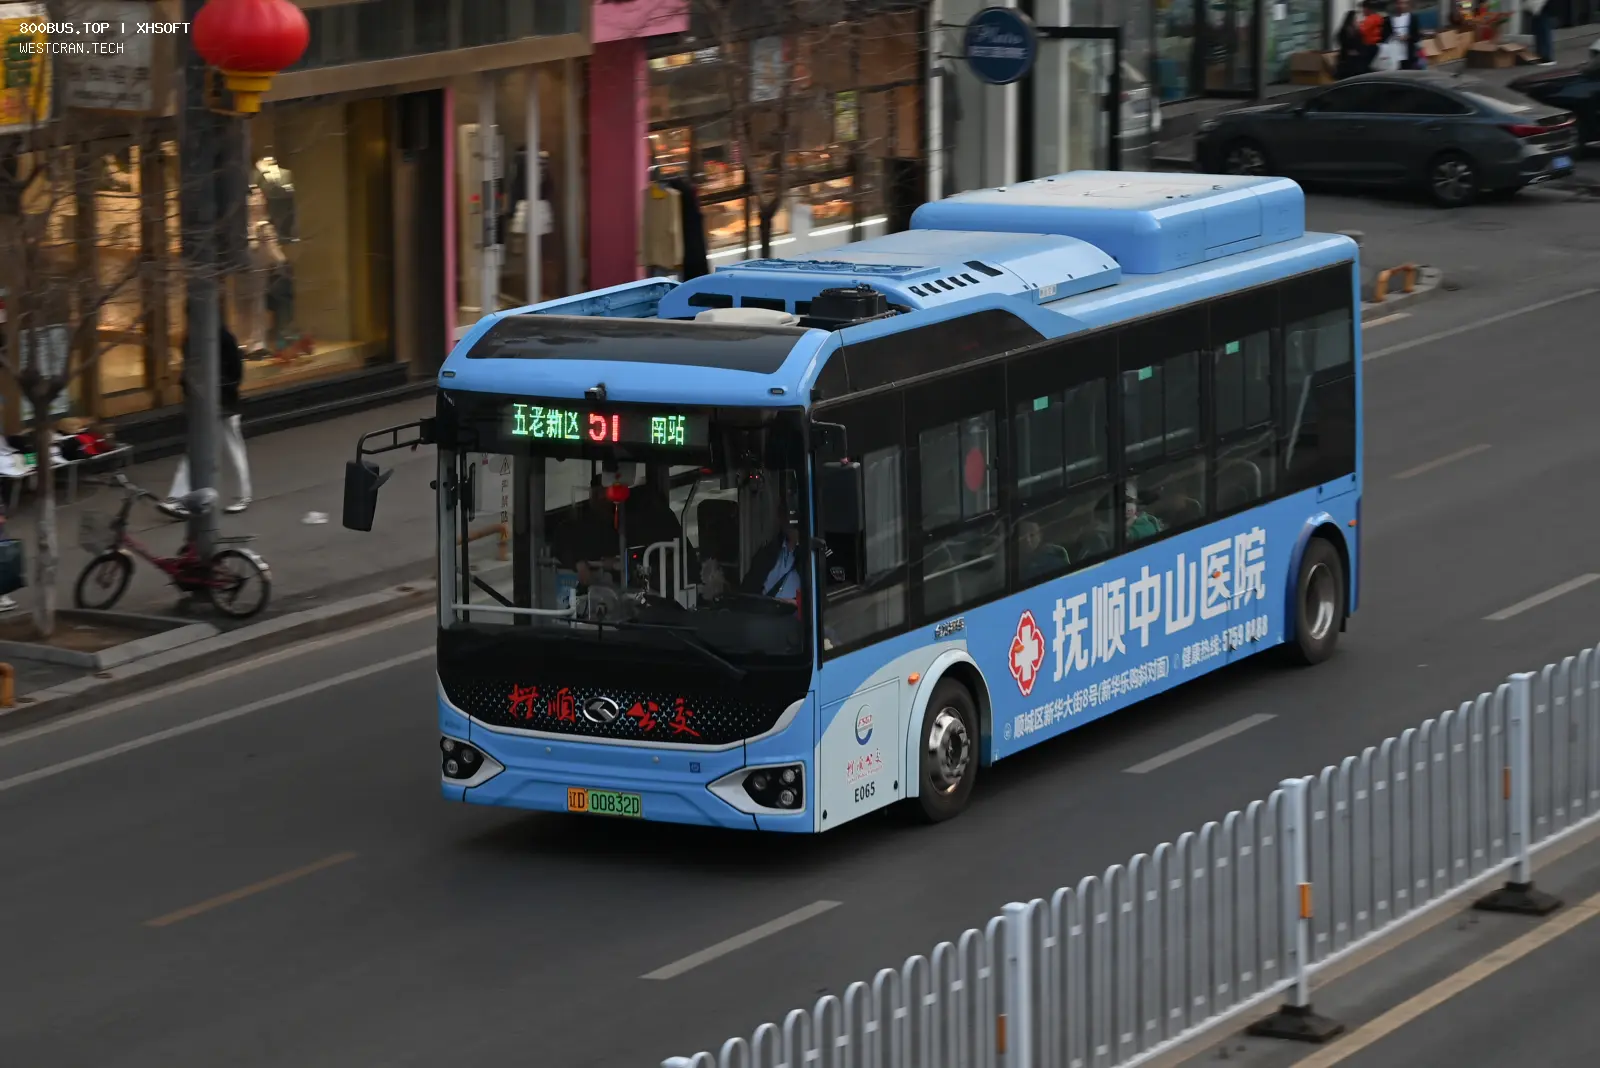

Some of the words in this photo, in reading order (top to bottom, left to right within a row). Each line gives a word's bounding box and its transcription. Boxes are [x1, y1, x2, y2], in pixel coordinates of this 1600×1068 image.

[512, 403, 580, 440] 五老新区
[588, 413, 620, 442] 51
[651, 414, 686, 446] 南站
[1052, 526, 1266, 682] 抚顺中山医院
[854, 781, 876, 803] E065
